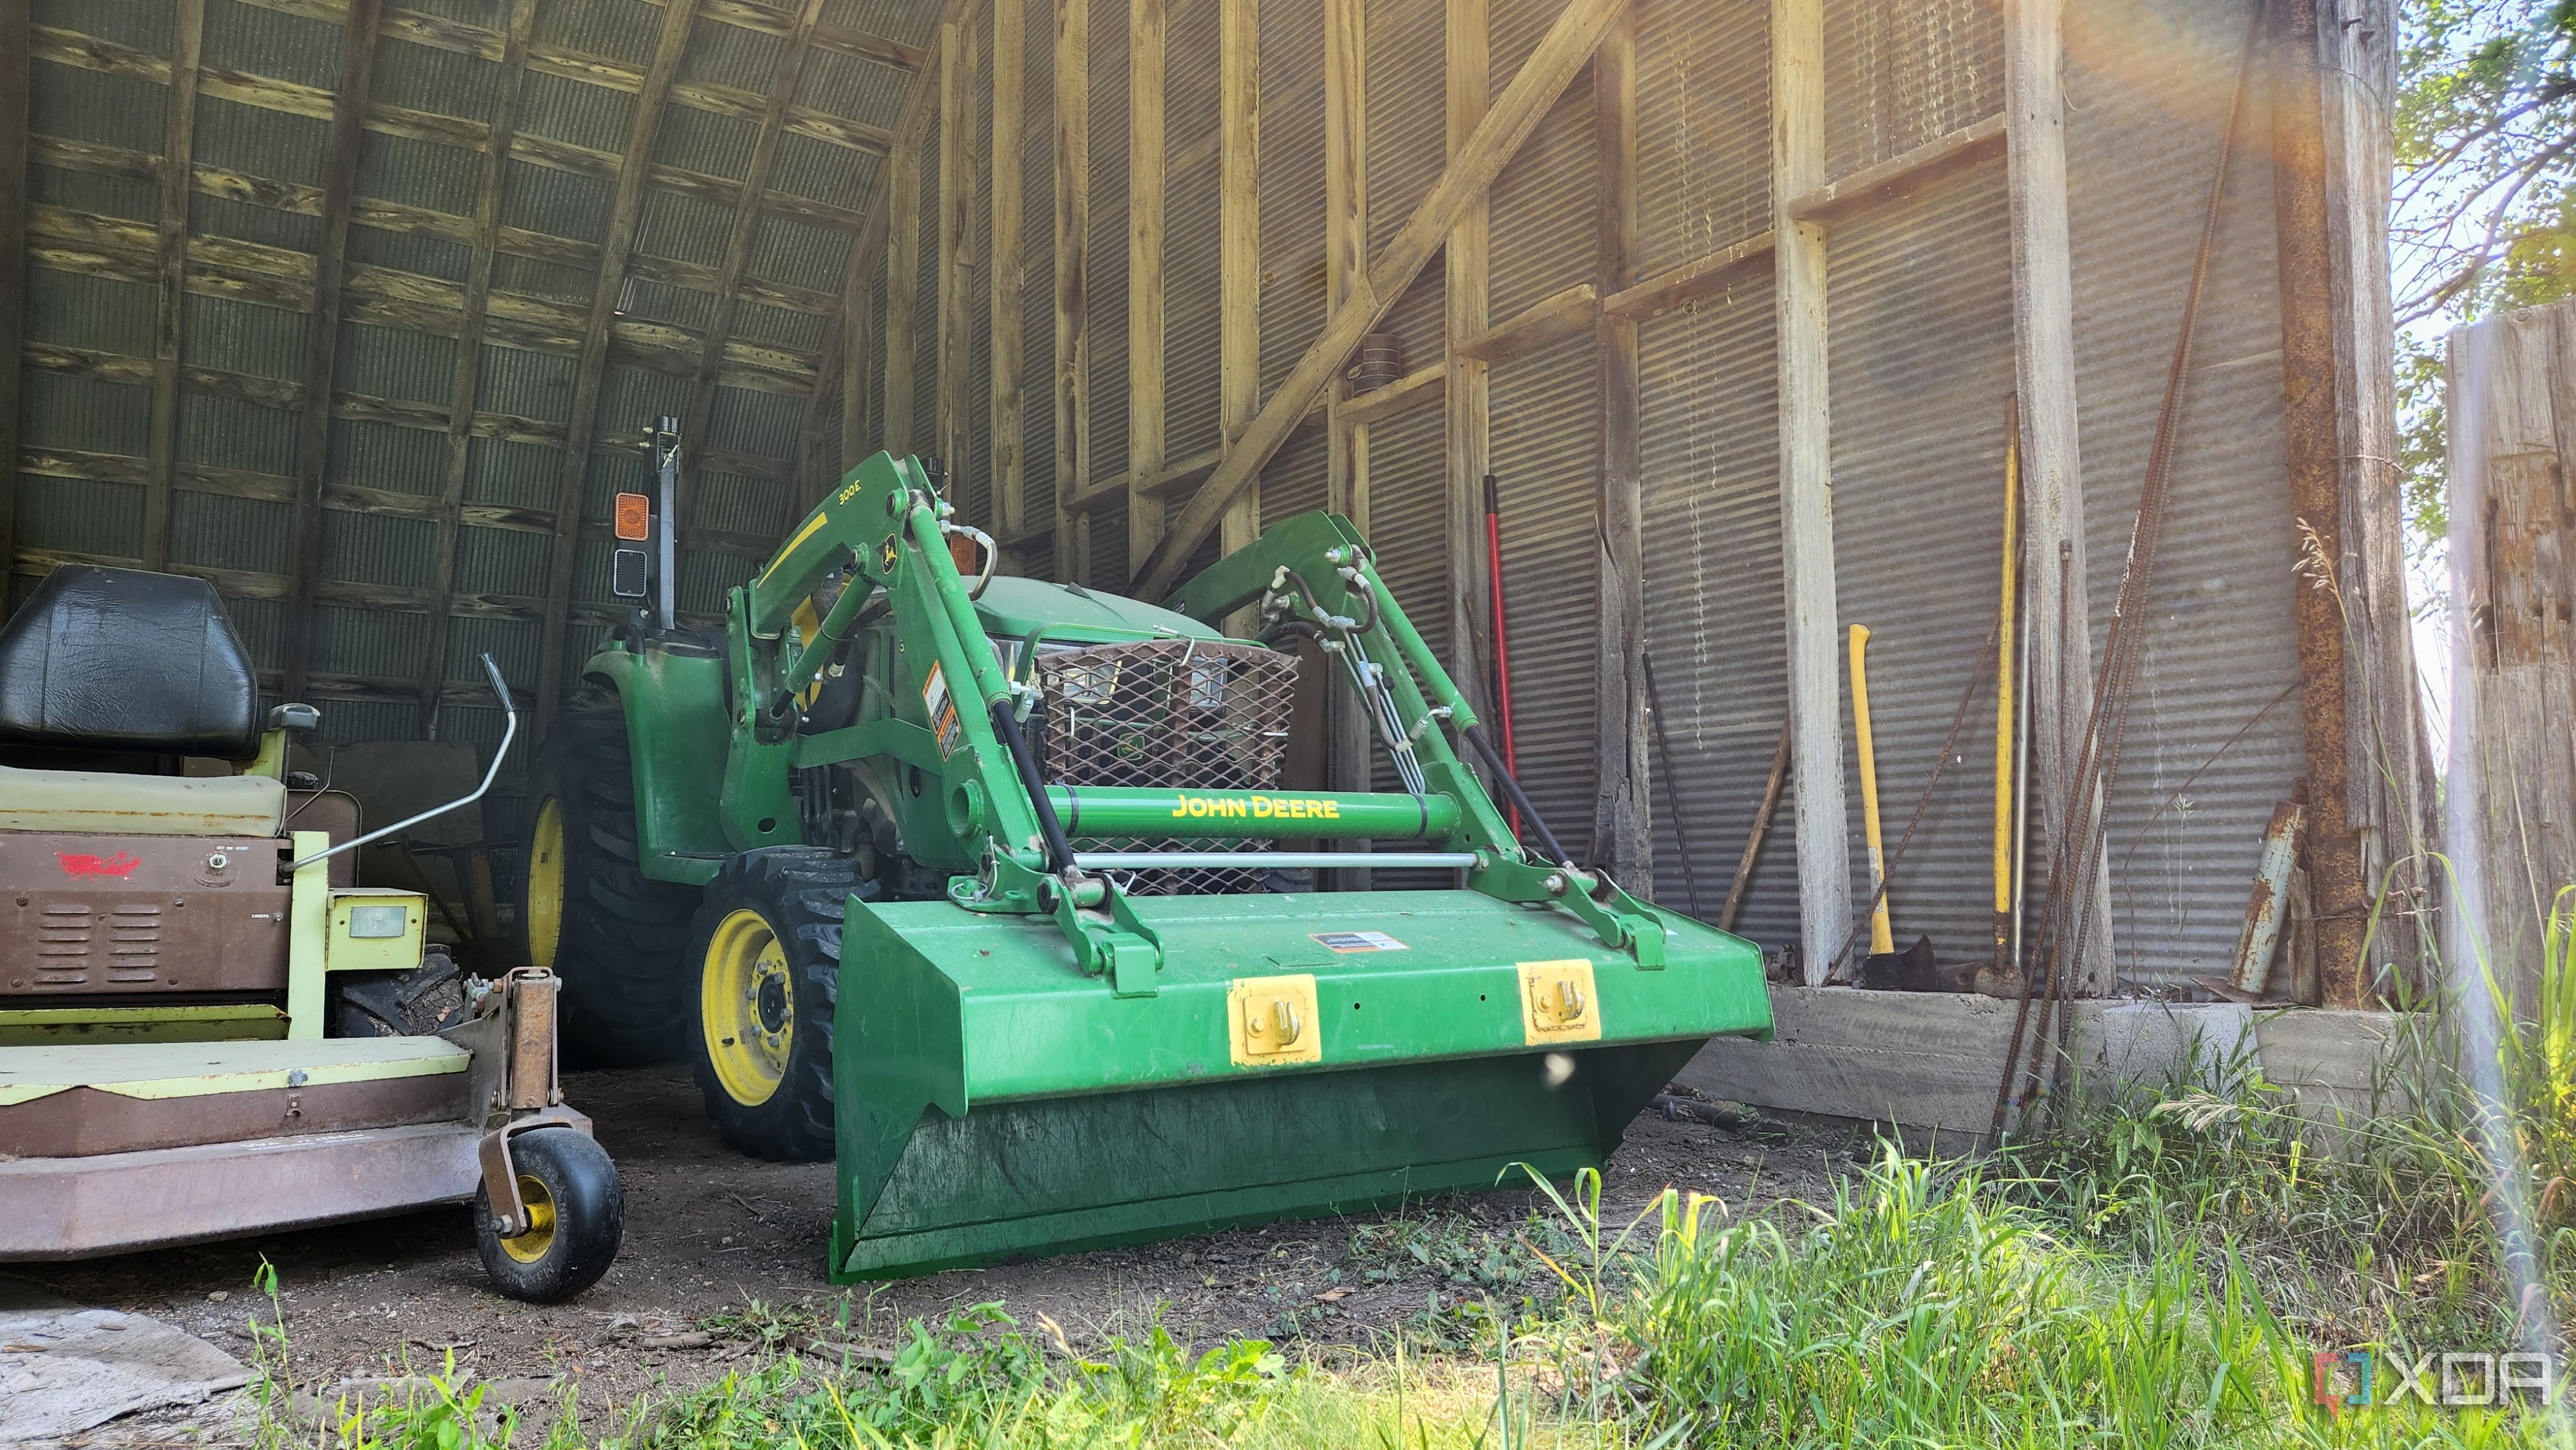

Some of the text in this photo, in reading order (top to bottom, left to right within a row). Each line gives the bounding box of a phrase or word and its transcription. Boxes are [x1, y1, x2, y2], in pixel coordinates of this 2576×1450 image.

[839, 480, 861, 505] 300E
[1172, 795, 1340, 818] JOHN DEERE
